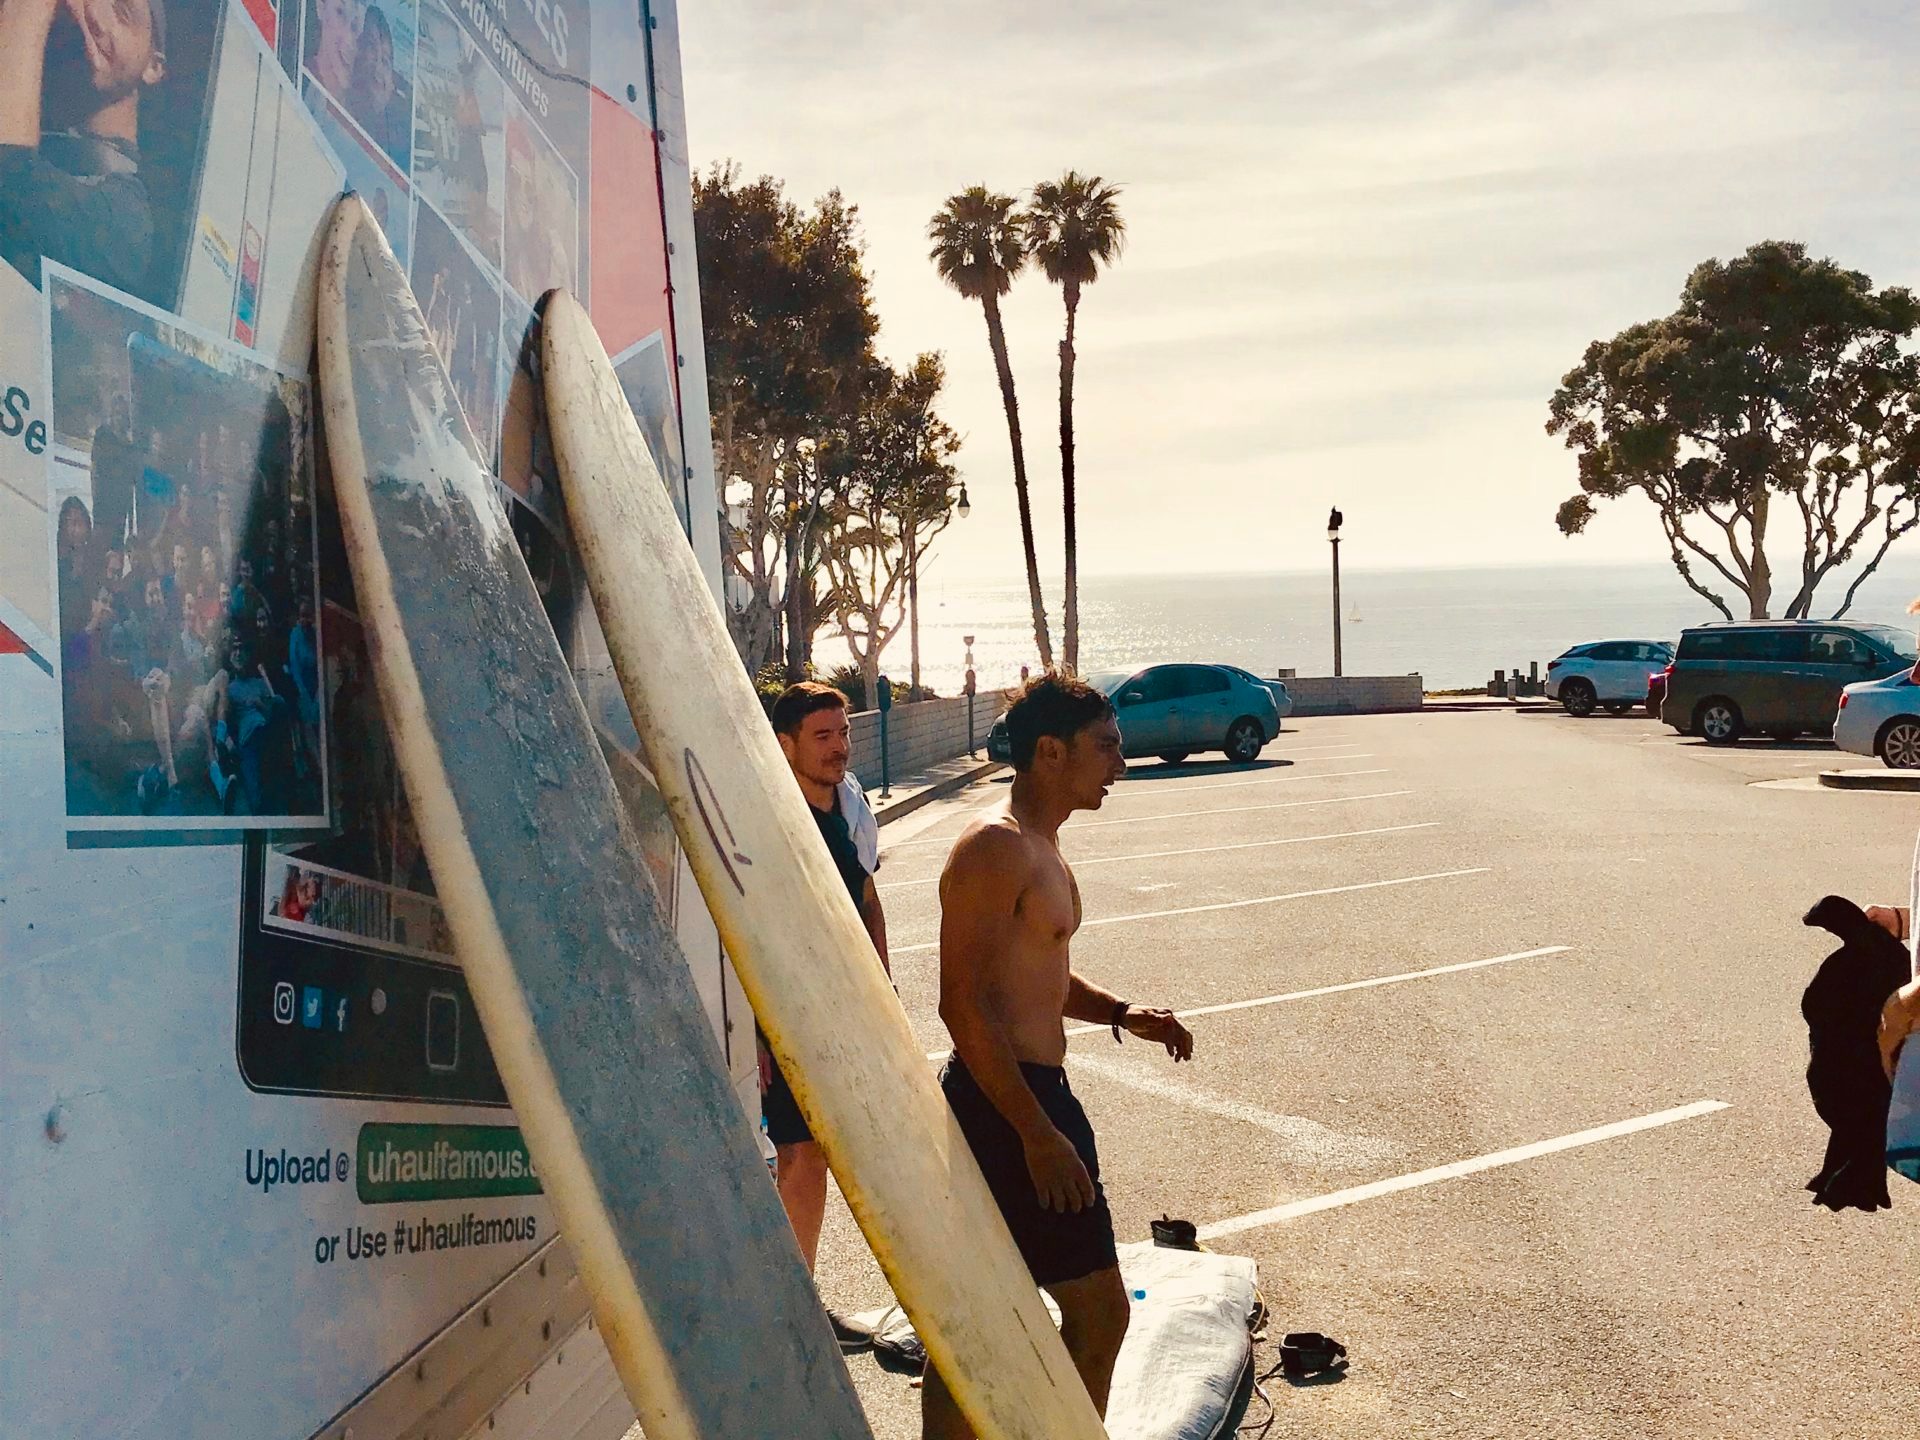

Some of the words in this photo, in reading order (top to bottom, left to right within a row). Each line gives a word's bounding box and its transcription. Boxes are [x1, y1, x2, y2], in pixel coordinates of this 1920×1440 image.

[245, 1148, 331, 1194] Upload
[315, 1235, 340, 1264] or
[346, 1226, 387, 1260] Use
[393, 1212, 536, 1254] #uhaulfamous
